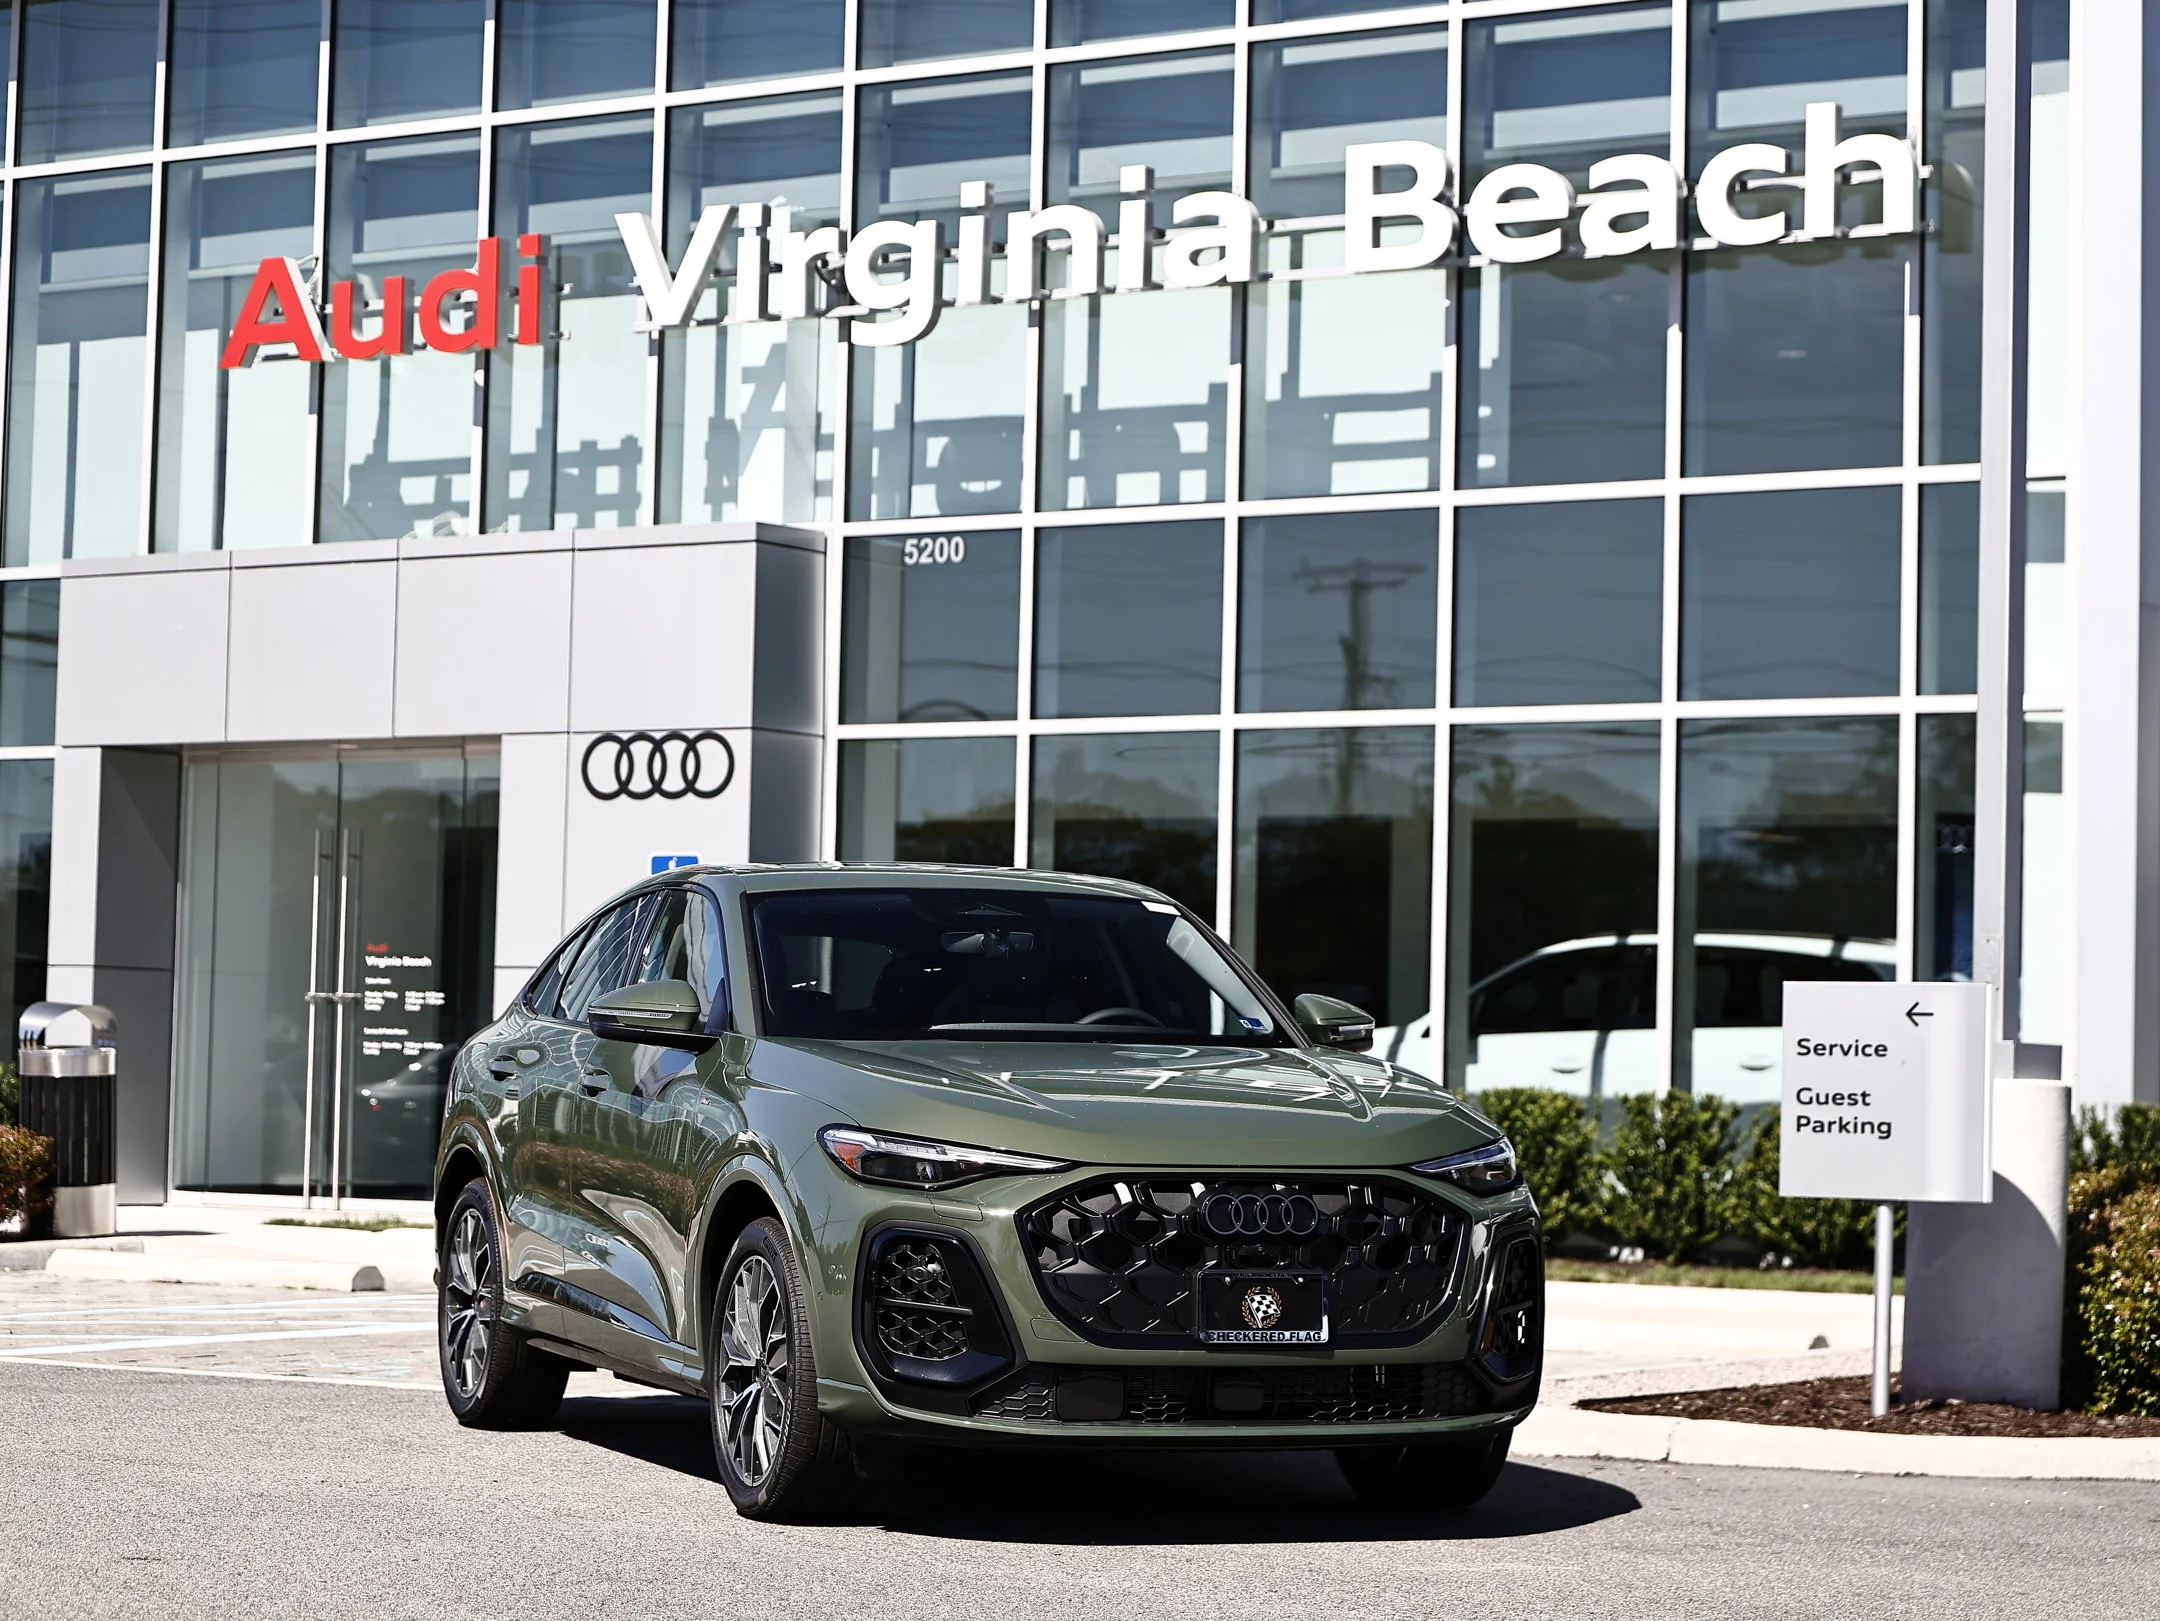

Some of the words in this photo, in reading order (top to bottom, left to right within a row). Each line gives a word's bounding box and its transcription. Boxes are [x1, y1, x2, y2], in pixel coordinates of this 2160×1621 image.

[220, 233, 549, 369] Audi
[615, 165, 1258, 346] Virginia
[1344, 102, 1917, 272] Beach
[903, 535, 965, 565] 5200
[1797, 1037, 1888, 1058] Service
[1796, 1086, 1872, 1107] Guest
[1796, 1115, 1893, 1140] Parking
[1208, 1331, 1286, 1342] CHECKERED
[1289, 1331, 1321, 1342] FLAG
